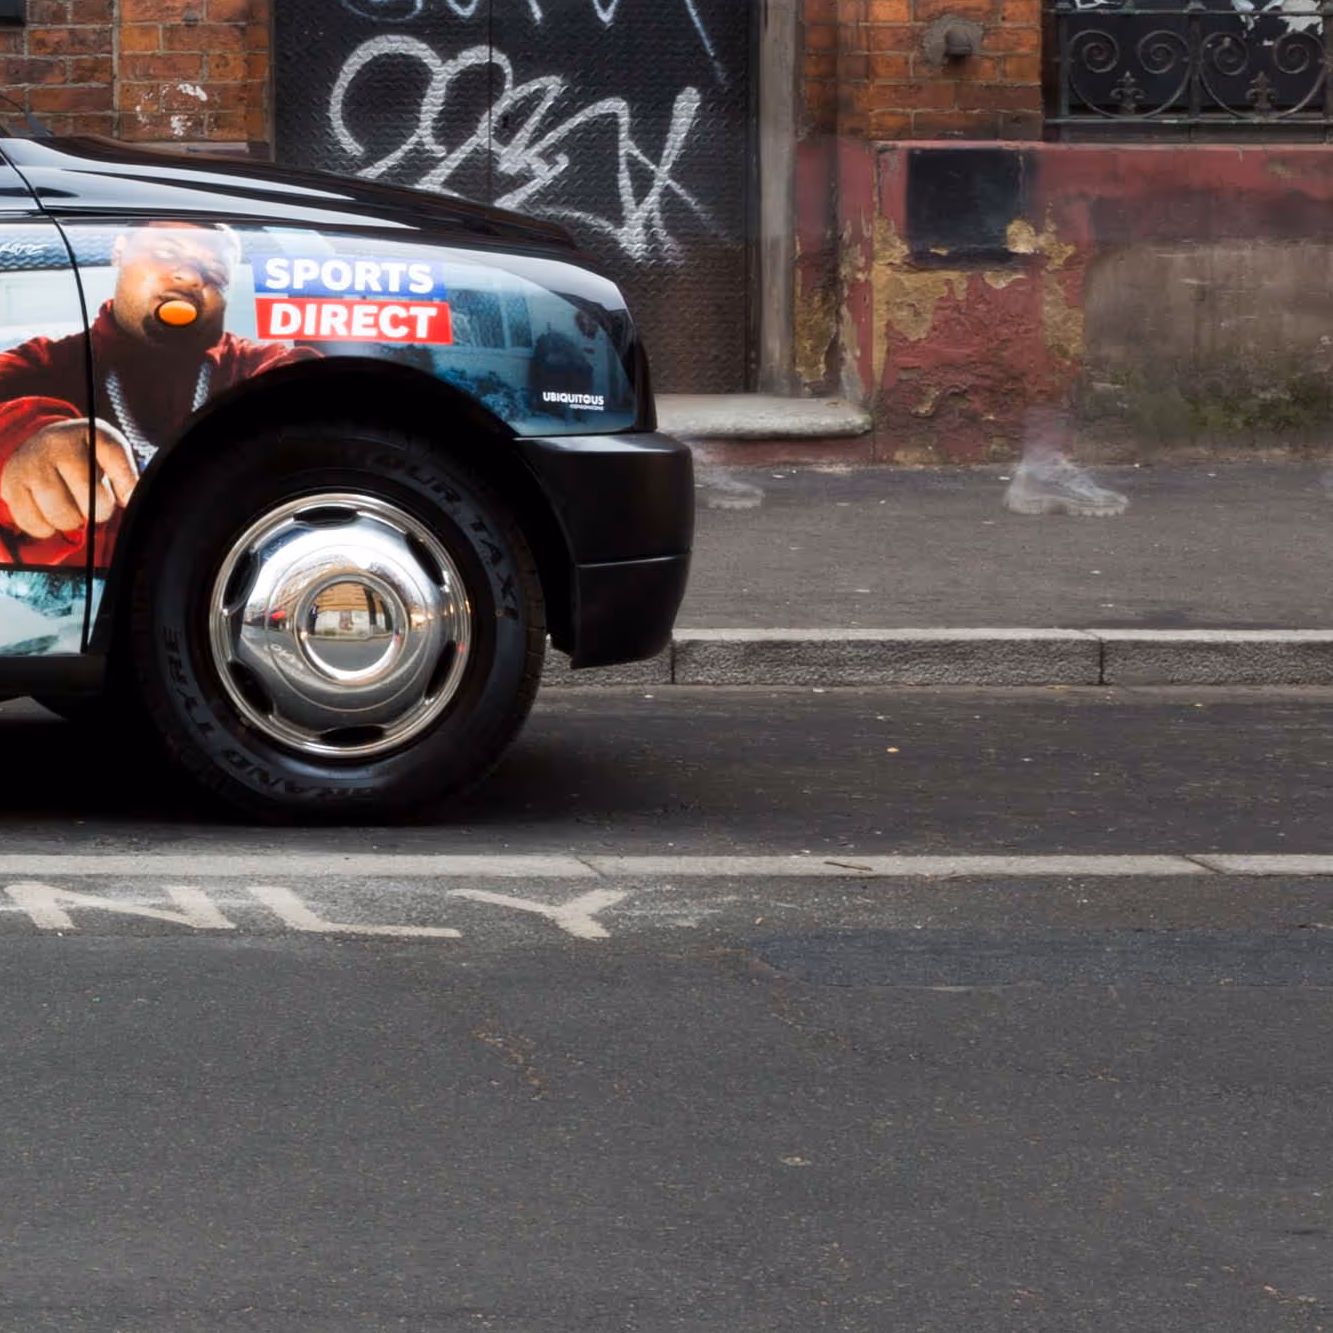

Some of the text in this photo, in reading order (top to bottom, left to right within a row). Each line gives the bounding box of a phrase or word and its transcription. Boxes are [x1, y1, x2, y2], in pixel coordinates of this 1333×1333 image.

[264, 257, 434, 294] SPORTS
[269, 302, 438, 340] DIRECT
[542, 391, 605, 406] UBIQUITOUS
